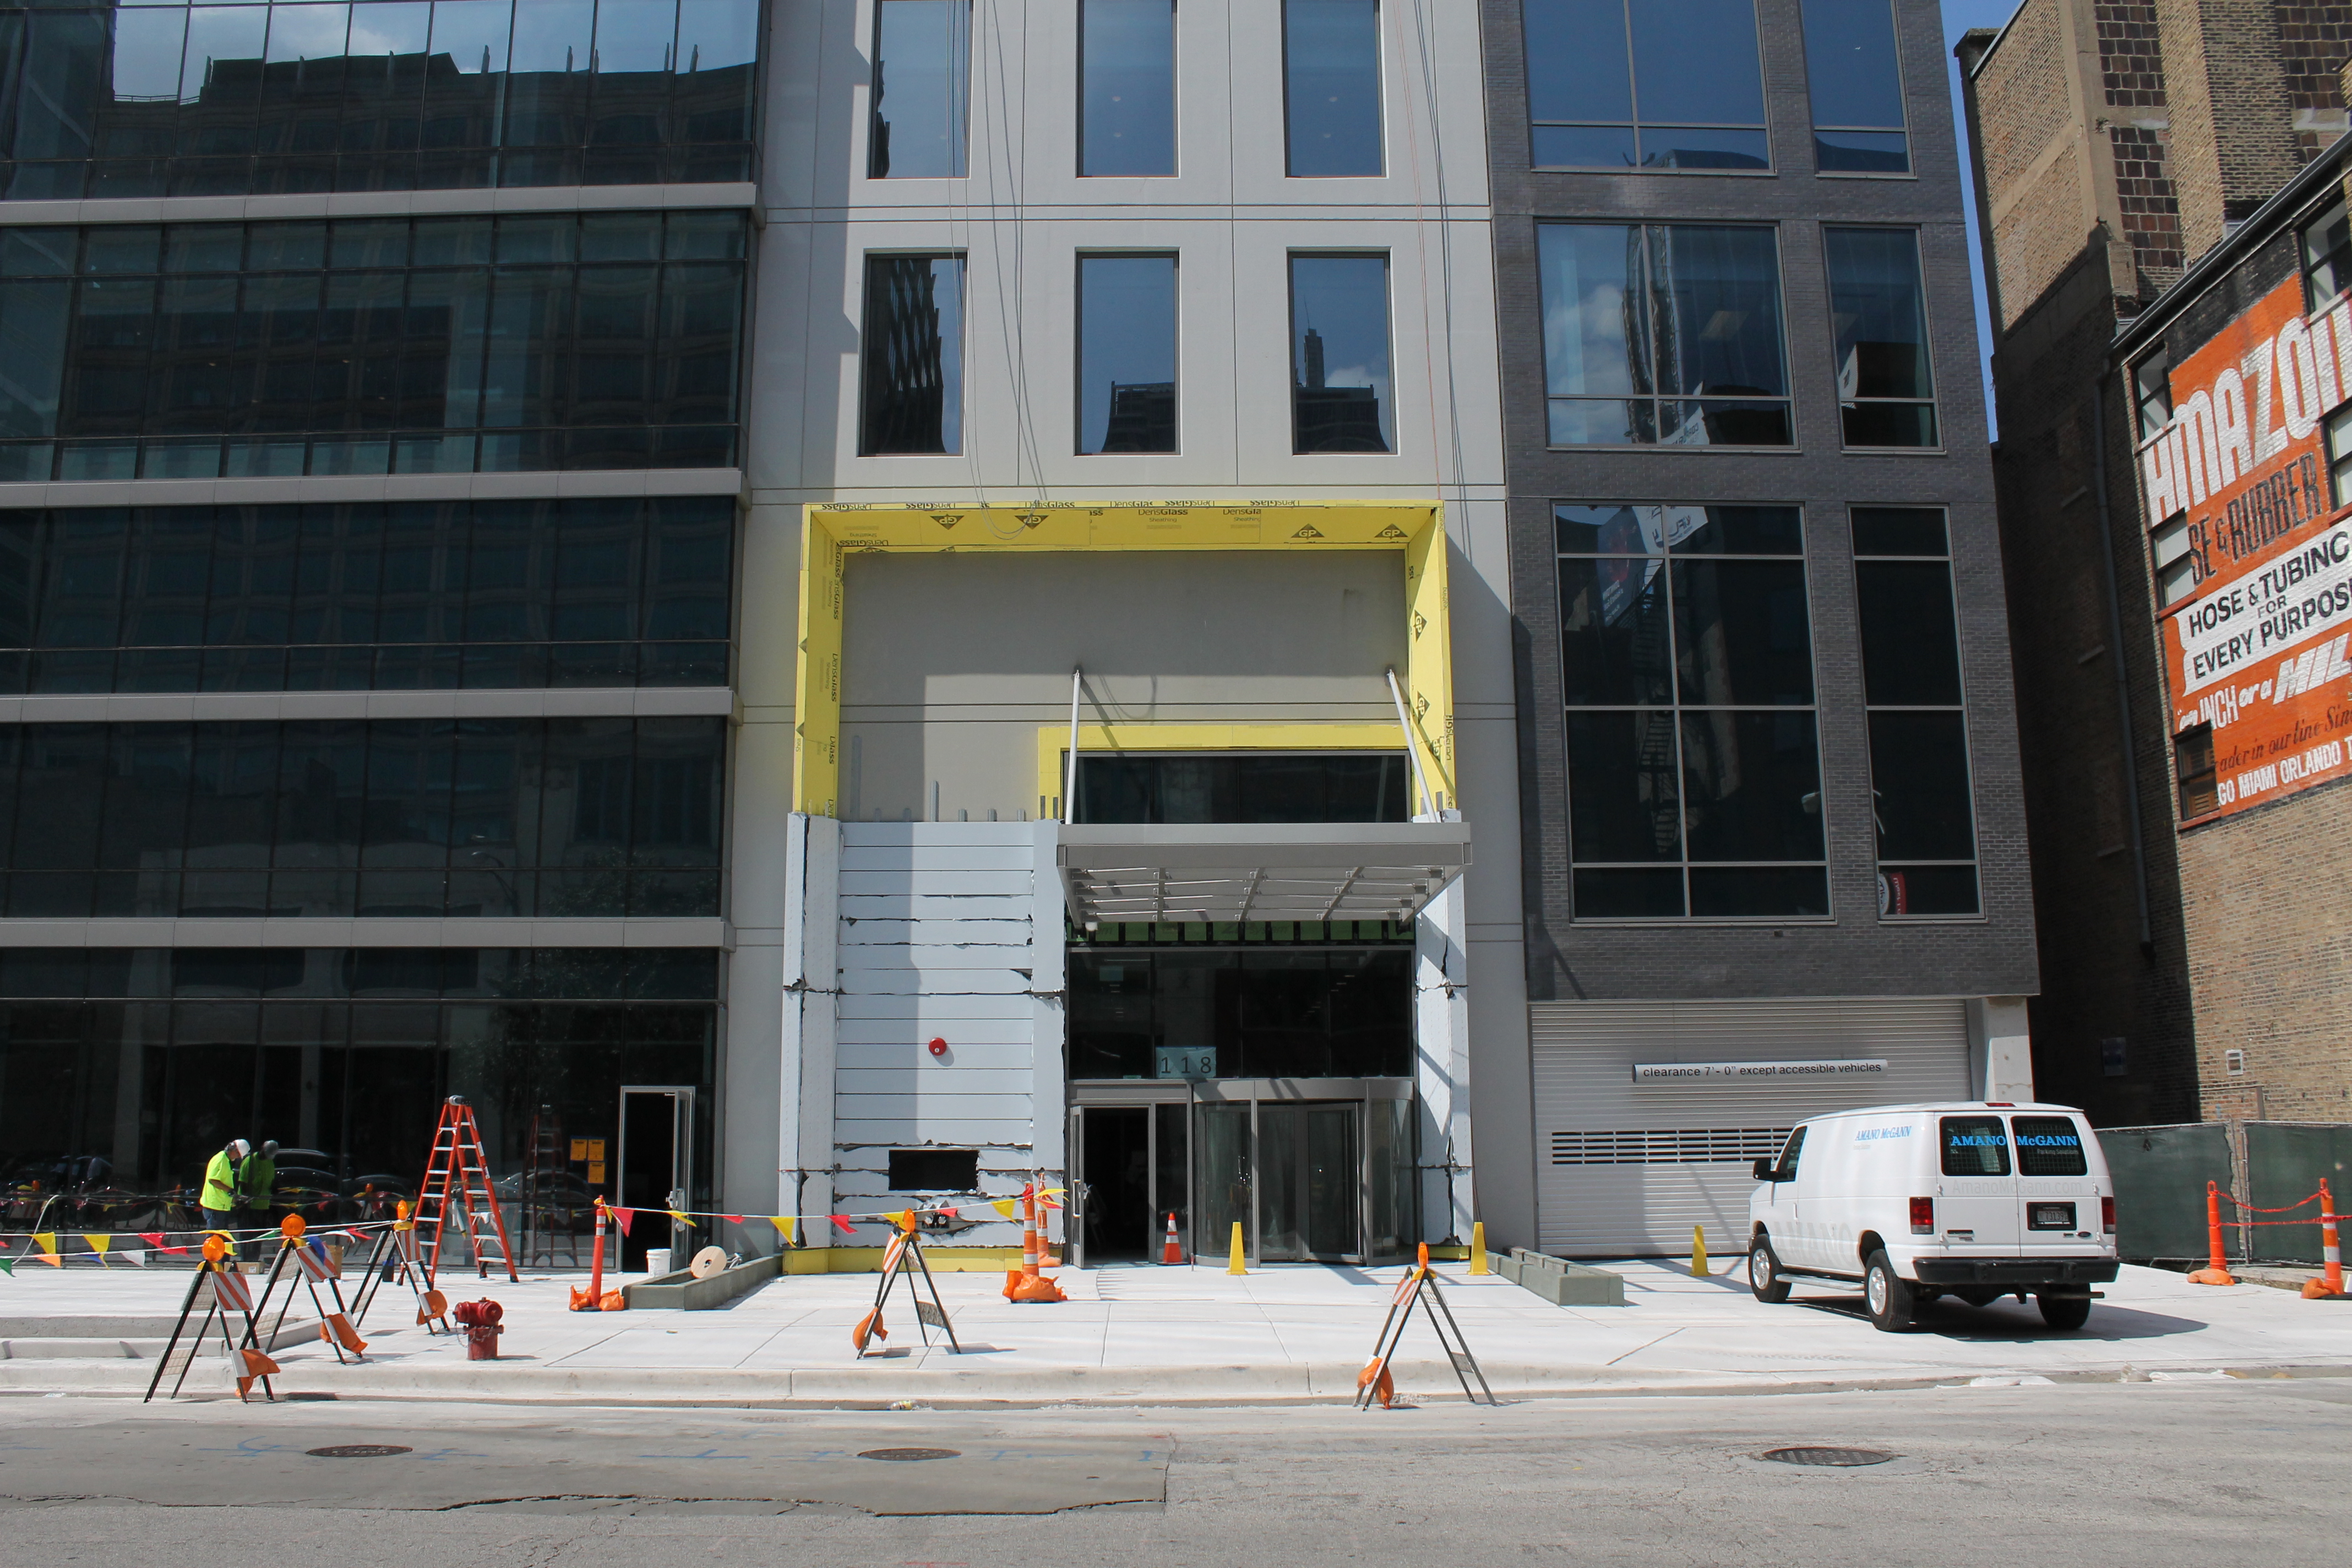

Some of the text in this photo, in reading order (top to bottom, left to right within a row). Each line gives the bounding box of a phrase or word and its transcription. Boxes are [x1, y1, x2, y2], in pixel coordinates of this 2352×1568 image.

[2215, 518, 2229, 556] &
[2227, 452, 2322, 564] RUBBER
[2189, 531, 2350, 638] HOSE & TUBING
[2258, 595, 2287, 618] FOR
[2193, 628, 2254, 679] EVERY
[2199, 685, 2239, 731] INCH
[2239, 683, 2260, 707] or
[2260, 678, 2273, 700] a
[2252, 738, 2264, 760] in
[2269, 734, 2292, 754] our
[2293, 719, 2322, 744] line
[2237, 763, 2278, 799] MIAMI
[2280, 741, 2342, 784] ORLANDO
[1643, 1066, 1701, 1077] clearance
[1740, 1065, 1776, 1076] except
[1779, 1064, 1836, 1074] accessible
[1838, 1063, 1881, 1072] vehicles
[1854, 1125, 1912, 1141] AMANO McGANN
[1951, 1135, 2078, 1146] AMANO McGANN
[1952, 1179, 2082, 1195] AmanoMcGann.com
